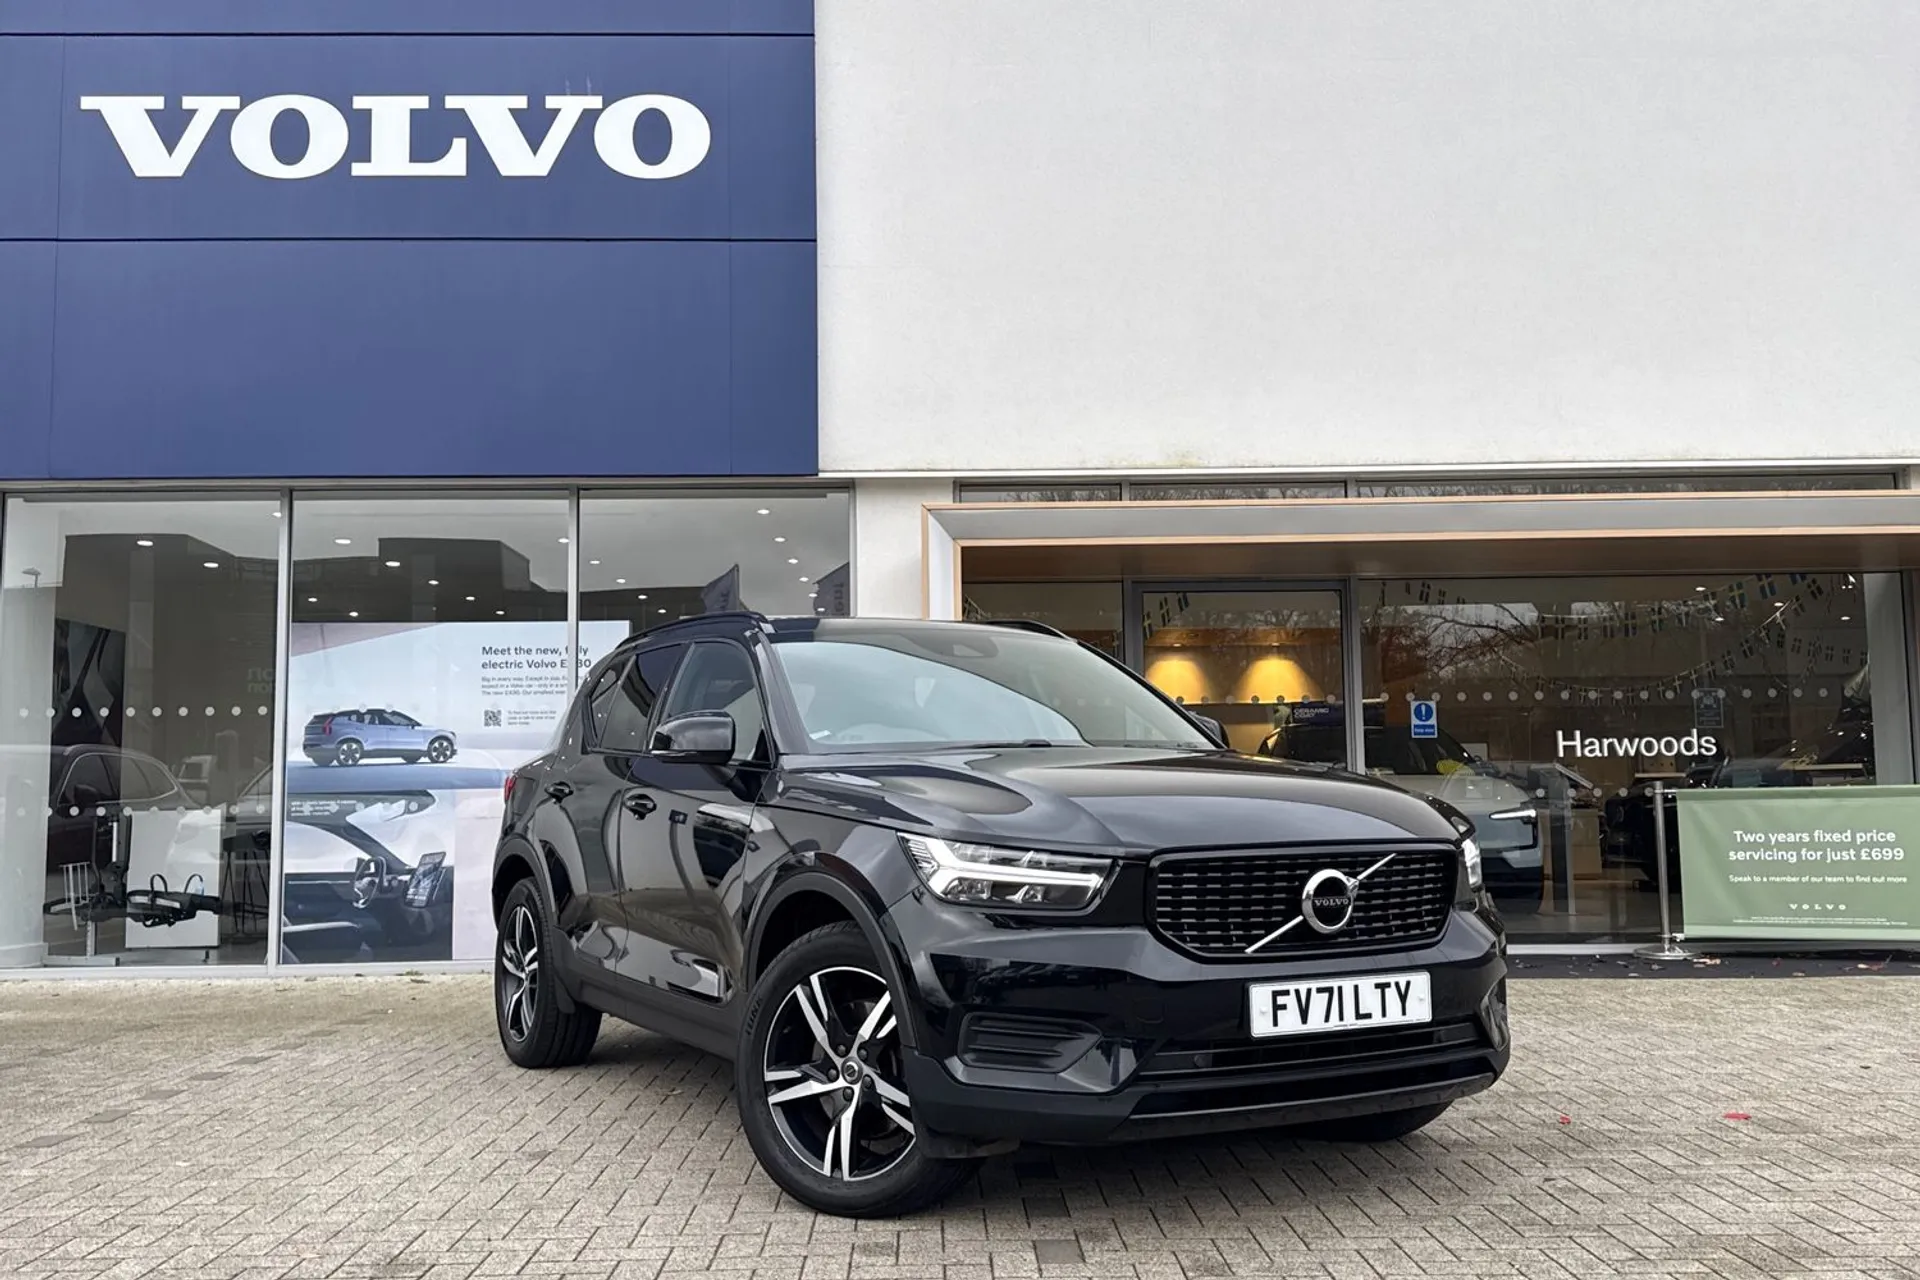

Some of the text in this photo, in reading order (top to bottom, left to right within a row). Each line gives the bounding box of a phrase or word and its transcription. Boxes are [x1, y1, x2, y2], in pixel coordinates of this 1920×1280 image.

[80, 94, 711, 180] VOLVO
[481, 646, 511, 656] Meet
[514, 645, 532, 656] the
[535, 647, 562, 657] new,
[481, 659, 523, 669] electric
[526, 659, 557, 669] Volvo
[1556, 728, 1717, 758] Harwoods
[1733, 830, 1896, 845] Two years fixed price
[1729, 848, 1905, 863] servicing for just £699
[1729, 875, 1752, 883] Speak
[1855, 875, 1869, 883] find
[1315, 898, 1349, 906] VOLVO
[1271, 980, 1411, 1028] FV71 LTY
